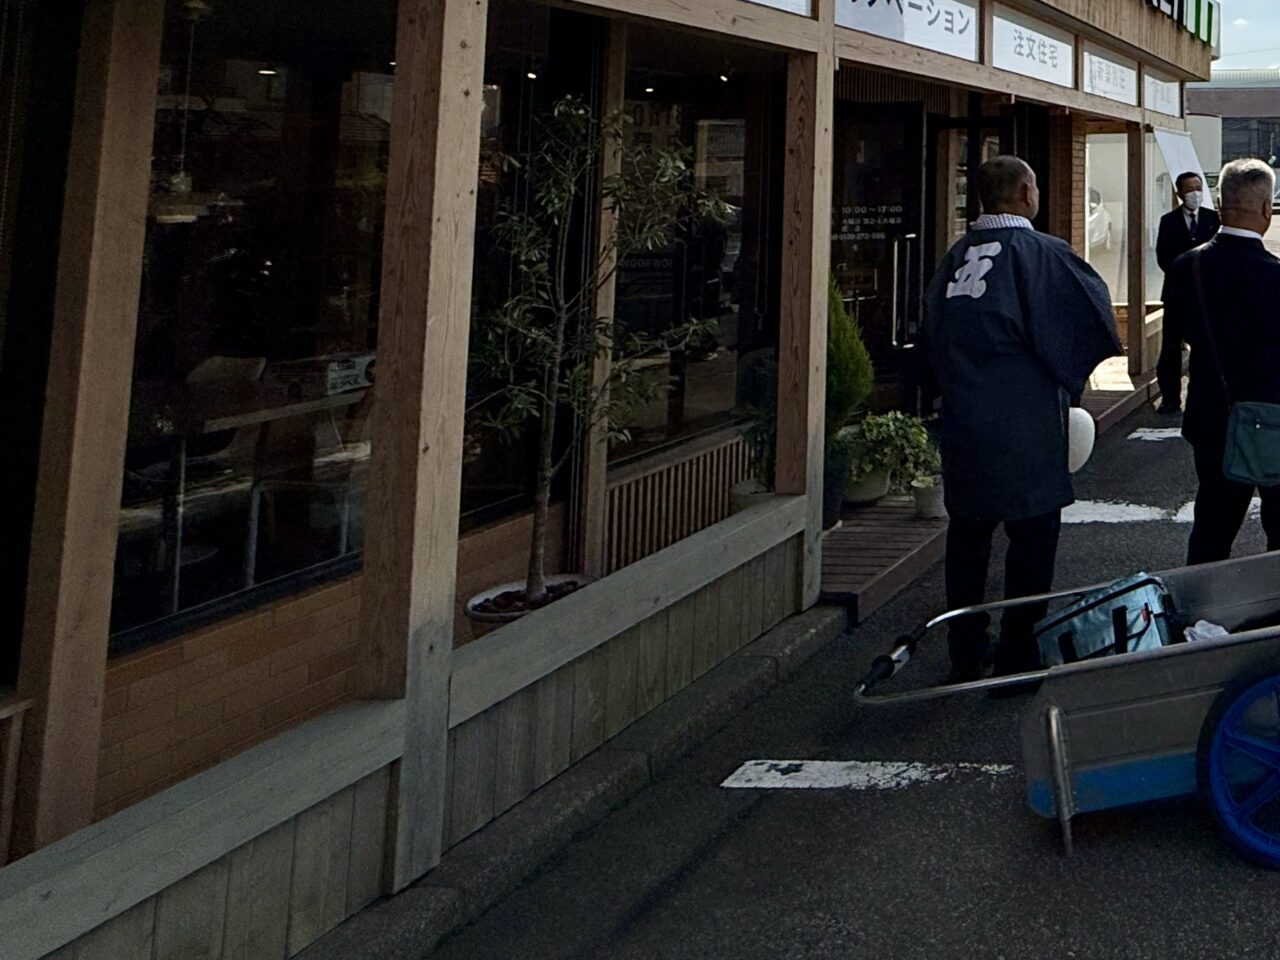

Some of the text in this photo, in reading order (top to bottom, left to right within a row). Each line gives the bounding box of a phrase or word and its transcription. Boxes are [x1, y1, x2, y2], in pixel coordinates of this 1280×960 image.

[1013, 29, 1058, 69] 注文住宅
[945, 241, 1002, 299] 五
